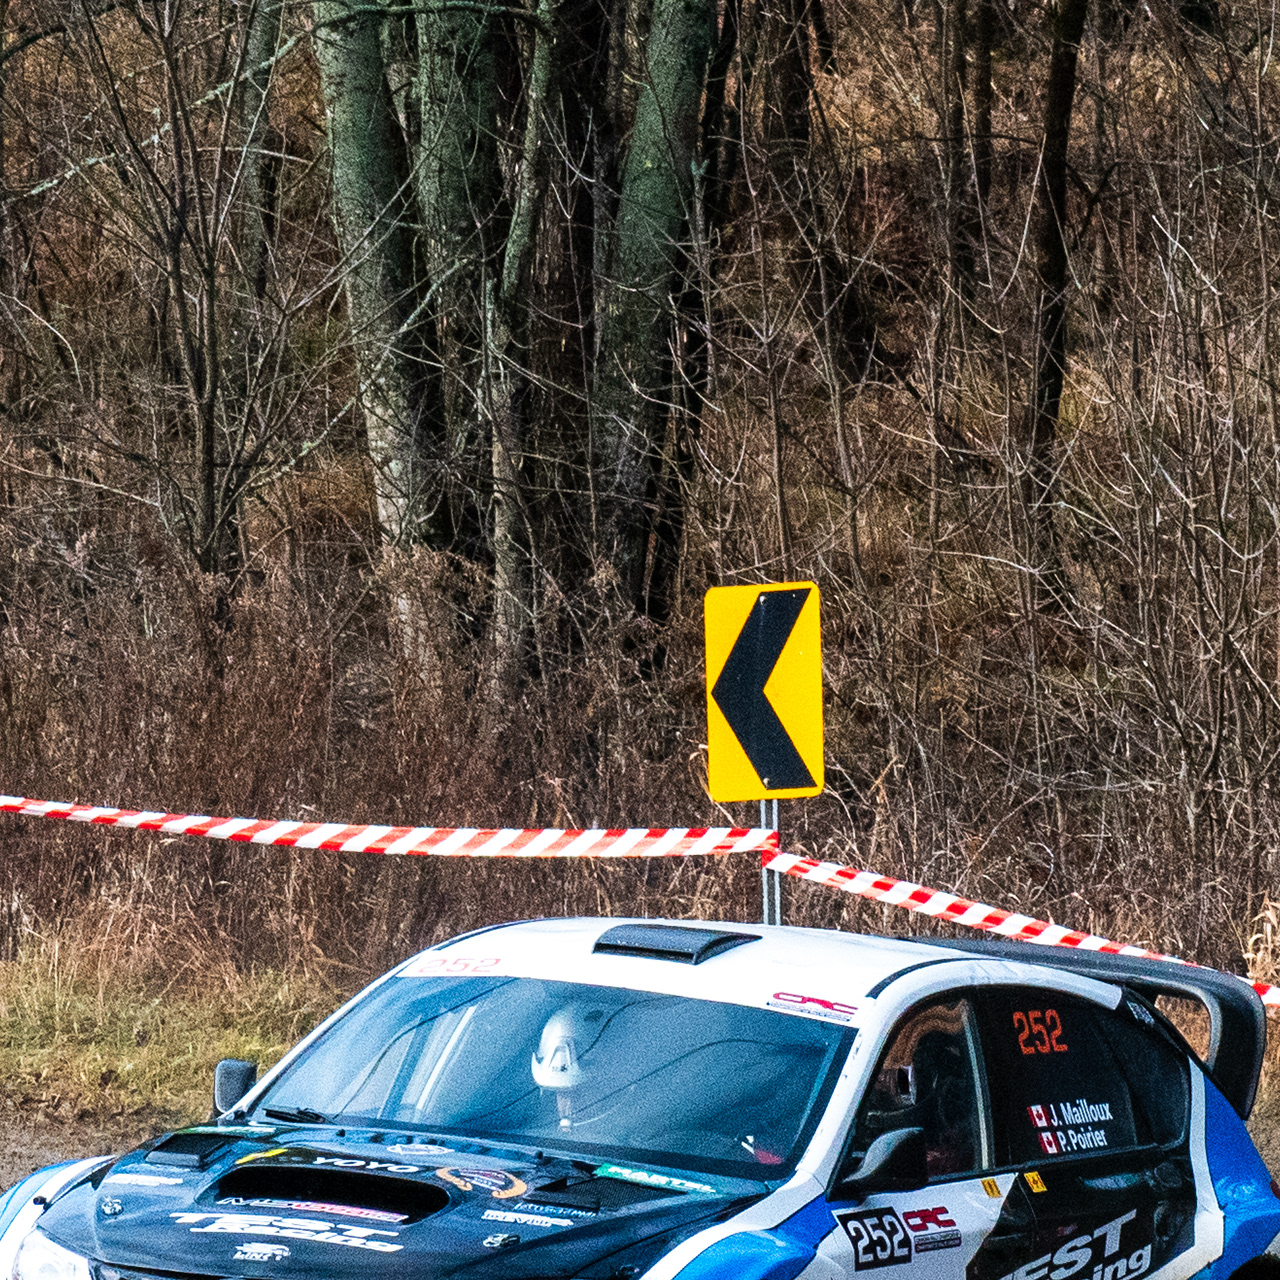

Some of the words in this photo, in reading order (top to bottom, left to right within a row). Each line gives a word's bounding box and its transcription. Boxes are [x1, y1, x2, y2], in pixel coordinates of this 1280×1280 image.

[418, 958, 501, 973] 252
[1013, 1009, 1068, 1055] 252
[1050, 1104, 1062, 1127] J.
[1060, 1099, 1113, 1126] Mailloux
[1056, 1131, 1070, 1152] P.
[1068, 1126, 1108, 1151] Poirier
[313, 1156, 419, 1173] YOYO
[170, 1212, 399, 1238] TEST
[847, 1214, 909, 1263] 252
